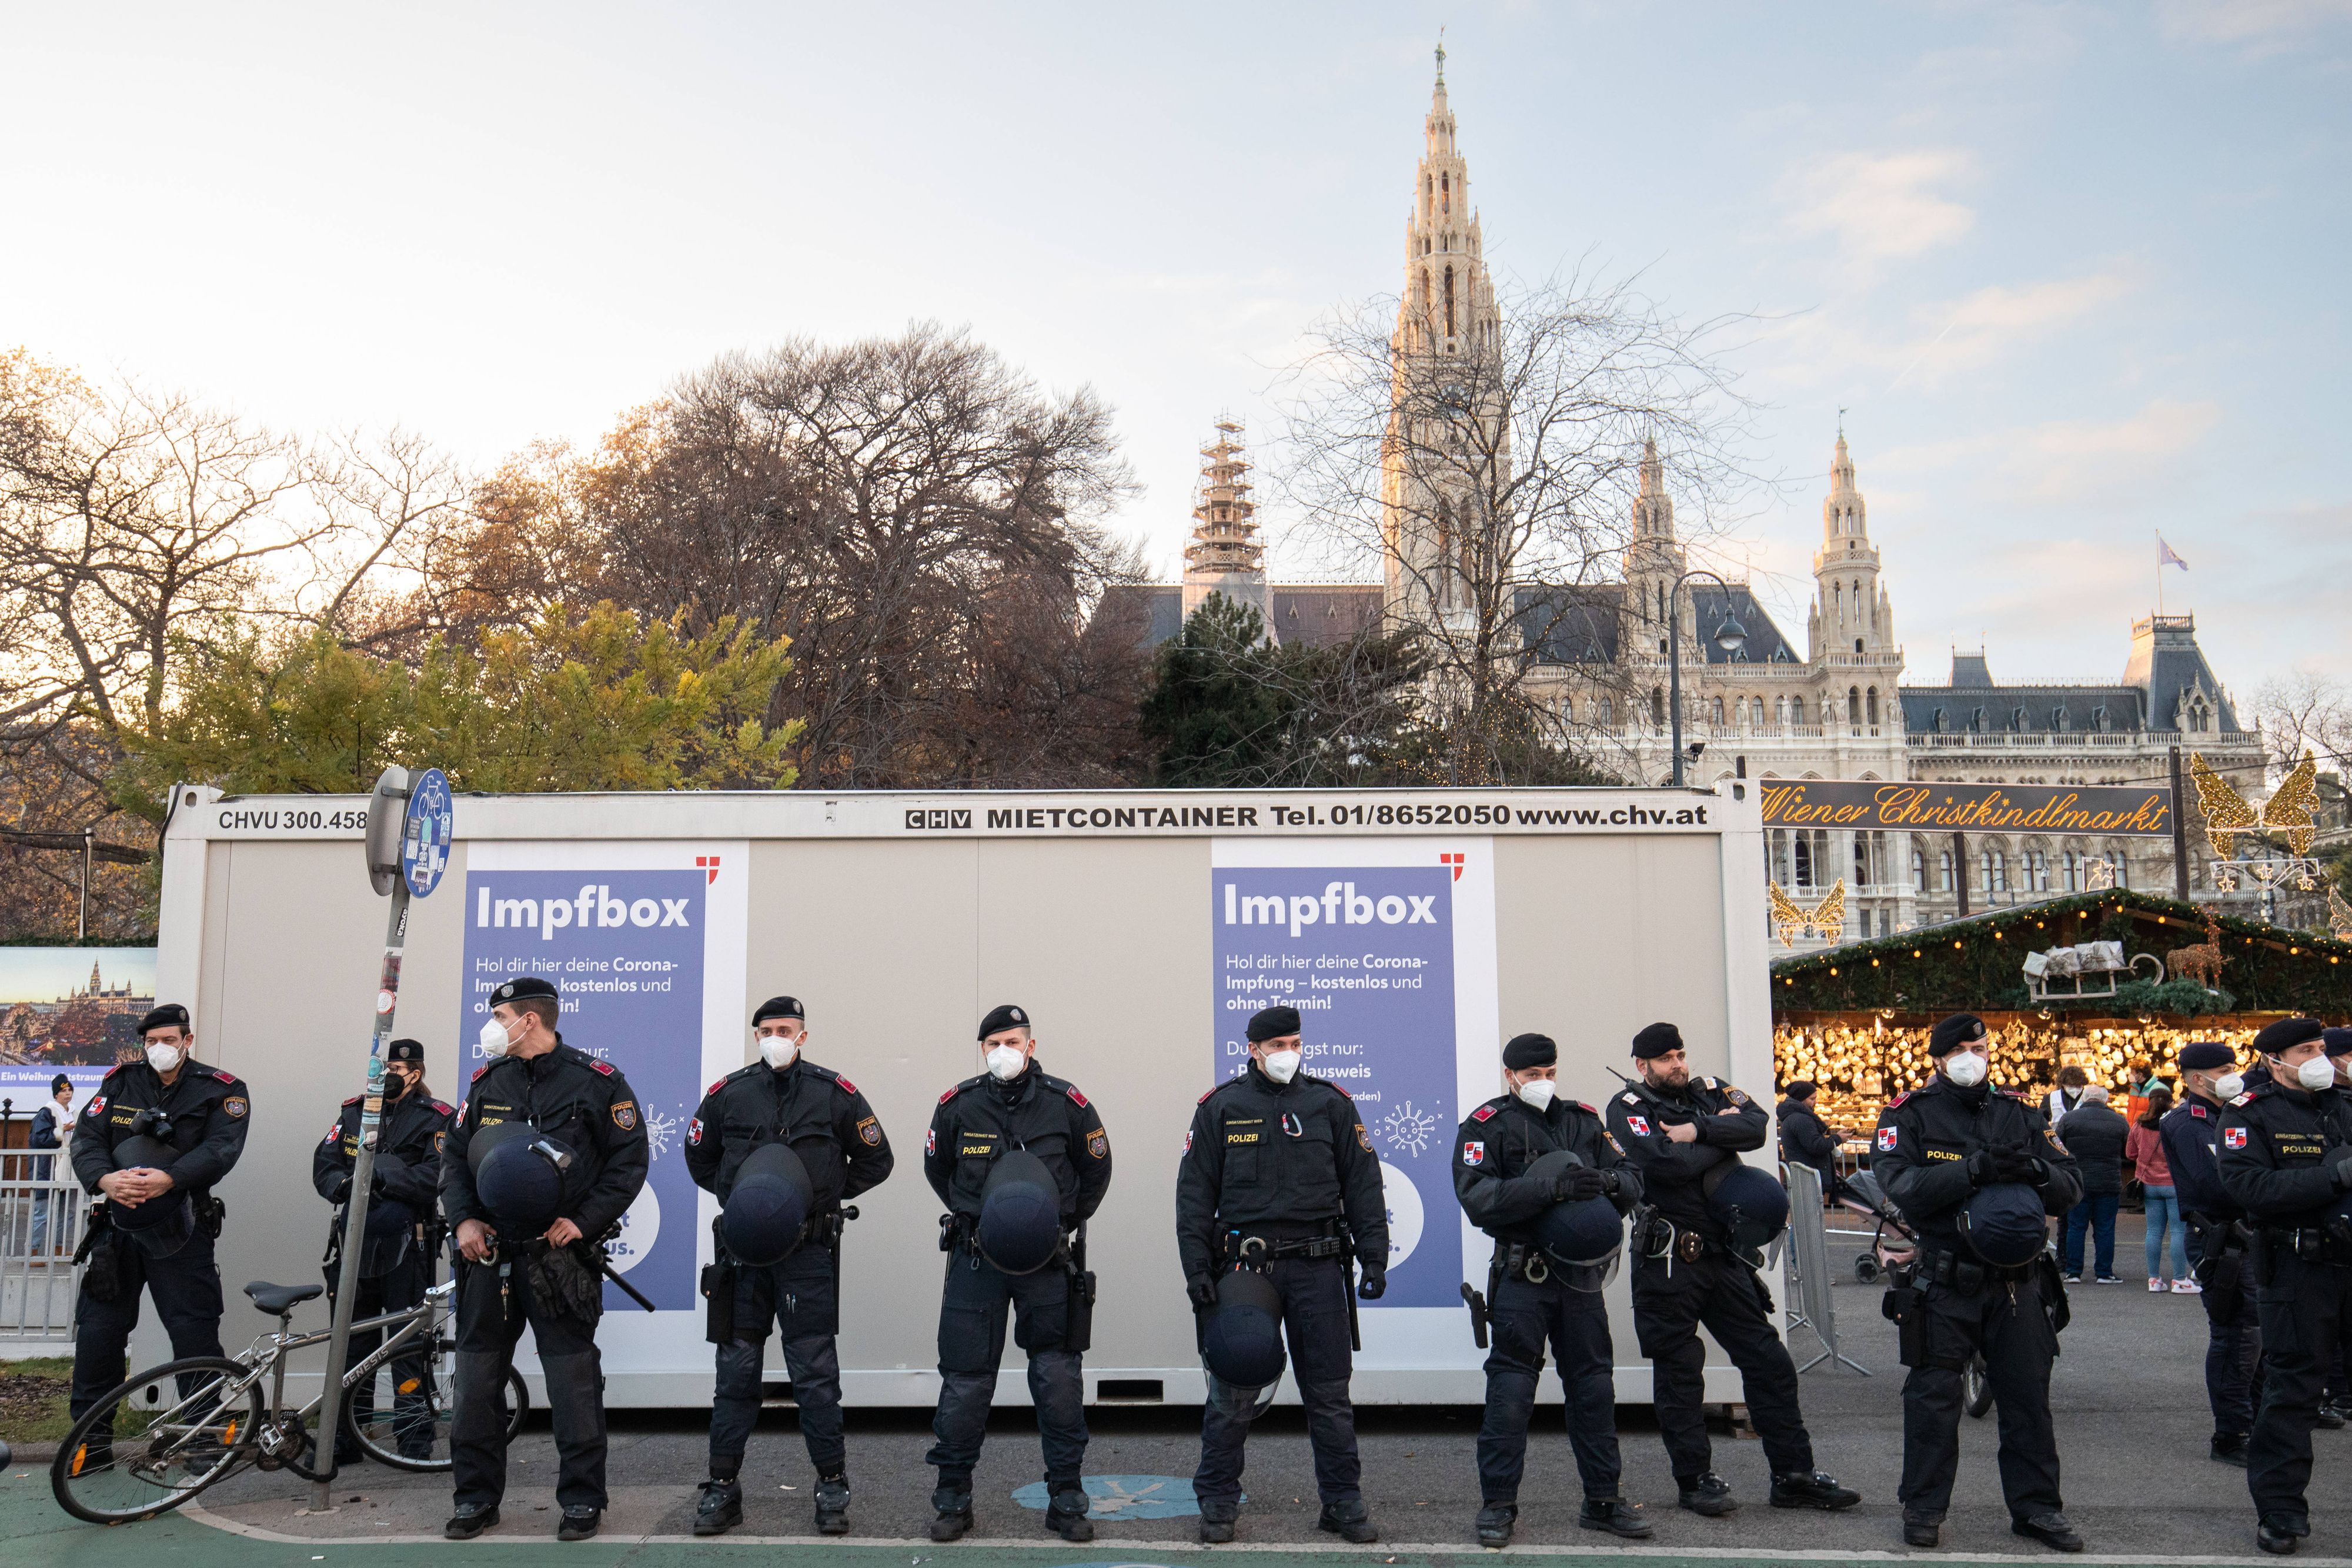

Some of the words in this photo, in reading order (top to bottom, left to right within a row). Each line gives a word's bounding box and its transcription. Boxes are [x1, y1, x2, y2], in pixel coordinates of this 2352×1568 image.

[1760, 785, 1870, 822] Wiener
[1874, 786, 2170, 831] Christkindlmarkt
[219, 811, 278, 829] CHVU
[283, 811, 368, 829] 300.458
[906, 810, 971, 829] CHV
[987, 807, 1258, 828] MIETCONTAINER
[1270, 805, 1325, 825] Tel.
[1330, 804, 1511, 825] 01/8652050
[1516, 804, 1708, 825] www.chv.at
[477, 884, 690, 941] Impfbox
[1224, 881, 1438, 938] Impfbox
[476, 957, 503, 972] Hol
[507, 957, 528, 972] dir
[532, 957, 562, 972] hier
[566, 957, 609, 972] deine
[613, 957, 679, 972] Corona-
[1226, 954, 1252, 969] Hol
[1257, 954, 1278, 969] dir
[1282, 954, 1312, 968] hier
[1315, 954, 1359, 968] deine
[1362, 954, 1429, 969] Corona-
[560, 977, 637, 992] kostenlos
[641, 977, 671, 992] und
[1226, 975, 1295, 993] Impfung
[1311, 974, 1388, 989] kostenlos
[1392, 974, 1422, 989] und
[1226, 995, 1267, 1010] ohne
[1271, 995, 1332, 1010] Termin!
[1227, 1041, 1248, 1056] Du
[1332, 1044, 1364, 1055] nur:
[1, 1072, 16, 1081] Ein
[1227, 1134, 1258, 1143] POLIZEI
[963, 1146, 991, 1155] POLIZEI
[1927, 1150, 1962, 1161] POLIZEI
[2282, 1145, 2321, 1154] POLIZEI
[342, 1346, 389, 1389] GENESIS
